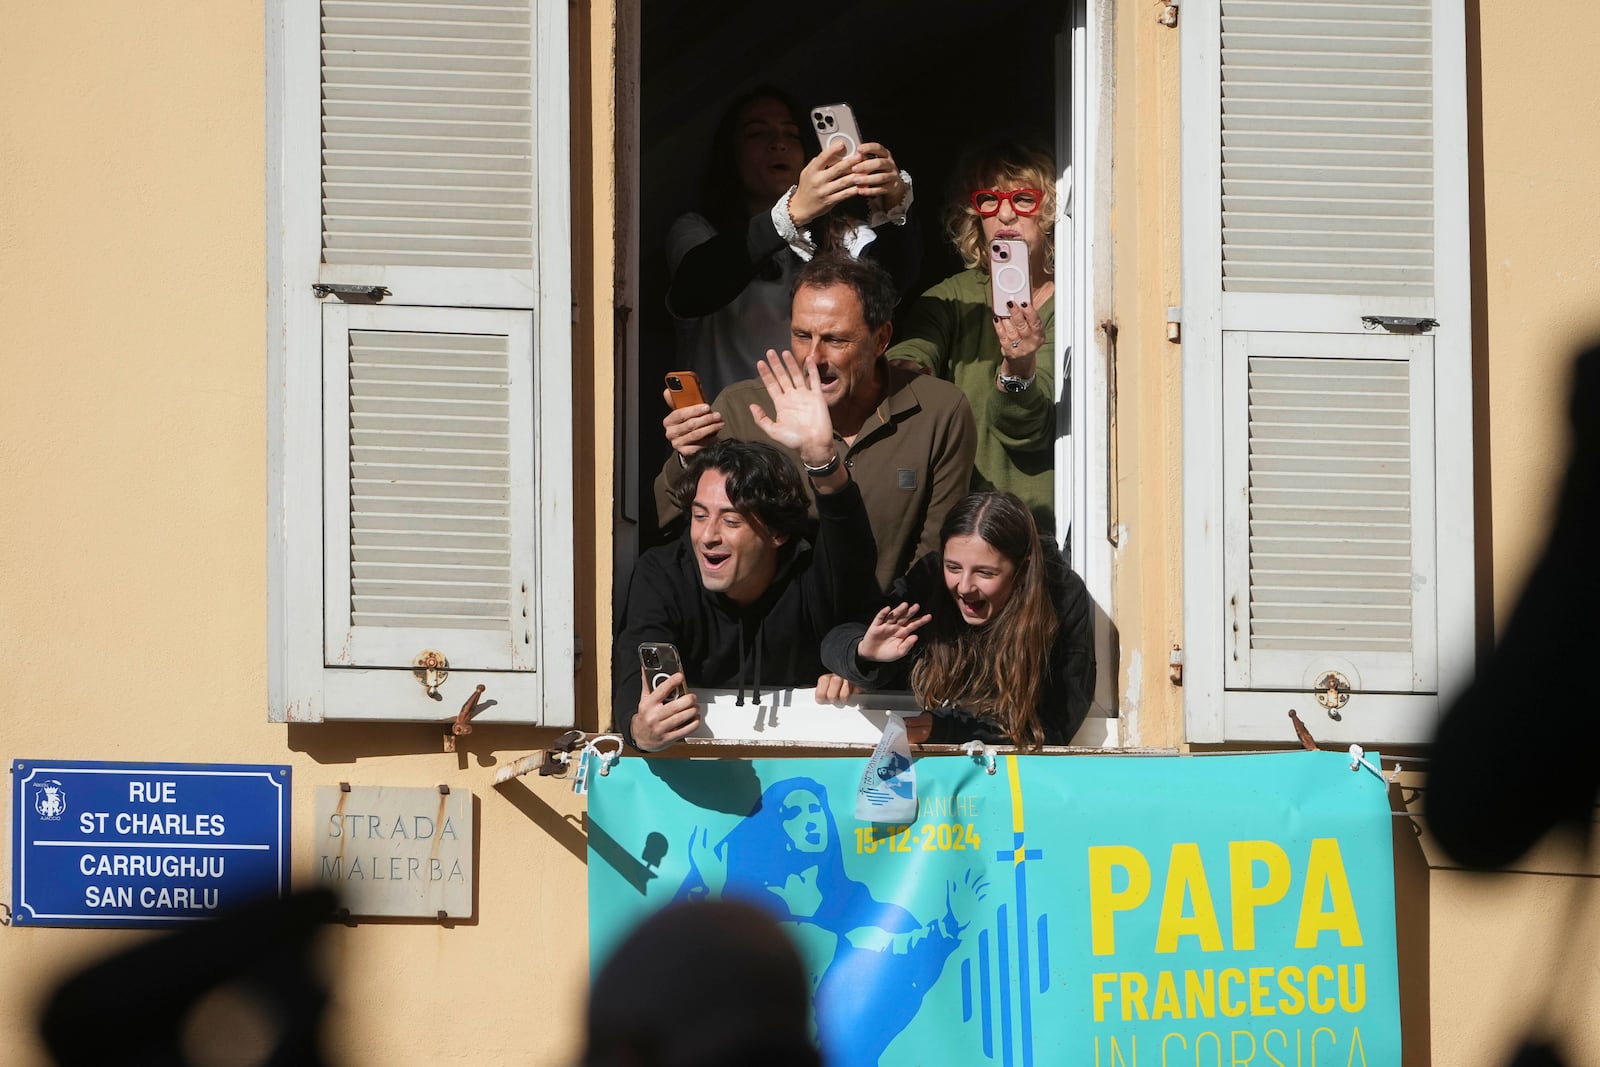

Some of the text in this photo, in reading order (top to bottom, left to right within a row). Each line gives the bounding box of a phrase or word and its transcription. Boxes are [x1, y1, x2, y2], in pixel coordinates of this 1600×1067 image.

[129, 781, 177, 803] RUE
[79, 812, 225, 836] ST CHARLES
[329, 814, 459, 840] STRADA
[79, 853, 225, 878] CARRUGHJU
[85, 886, 219, 909] SAN CARLU
[1088, 838, 1363, 956] PAPA
[1092, 964, 1366, 1022] FRANCESCU
